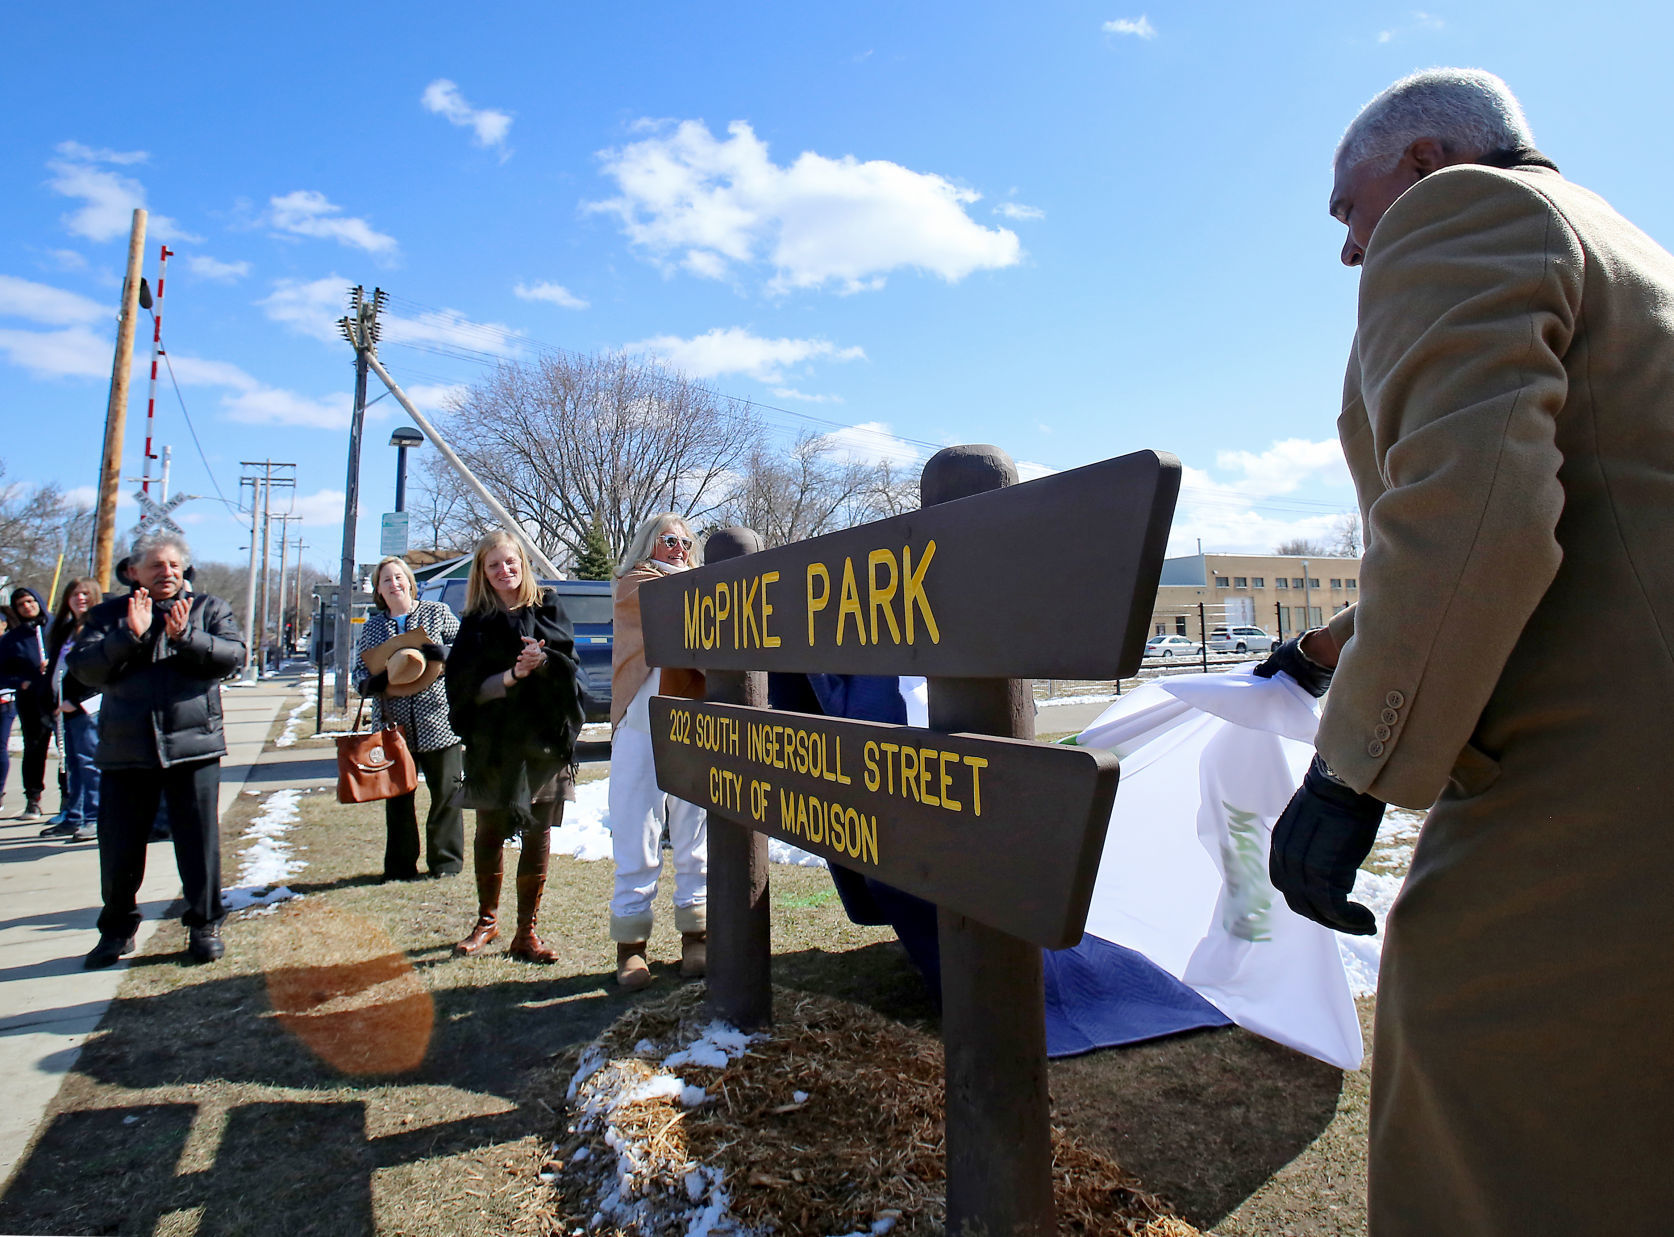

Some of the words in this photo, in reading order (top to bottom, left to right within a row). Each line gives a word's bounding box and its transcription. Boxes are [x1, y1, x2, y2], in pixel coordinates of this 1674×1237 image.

[806, 539, 941, 647] PARK
[669, 708, 691, 745] 202
[695, 712, 740, 757] SOUTH
[747, 721, 852, 786] INGERSOLL
[863, 740, 989, 817] STREET
[709, 766, 743, 813] CITY
[750, 779, 772, 823] OF
[780, 787, 880, 866] MADISON
